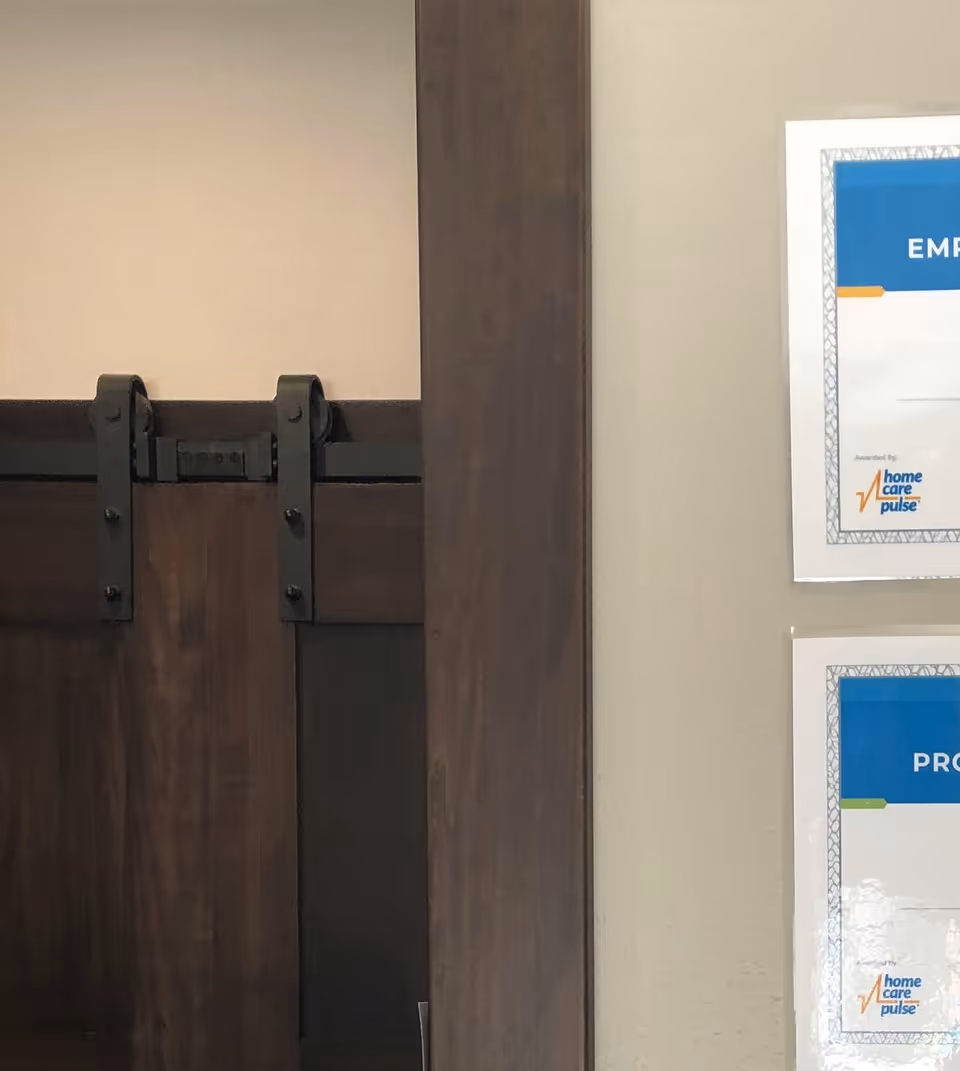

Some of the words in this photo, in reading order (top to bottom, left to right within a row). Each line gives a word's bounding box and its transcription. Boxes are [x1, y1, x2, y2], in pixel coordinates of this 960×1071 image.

[884, 469, 922, 483] home
[883, 485, 912, 495] care
[880, 496, 917, 515] pulse
[884, 974, 922, 987] home
[883, 989, 911, 999] care
[881, 1000, 916, 1017] pulse
